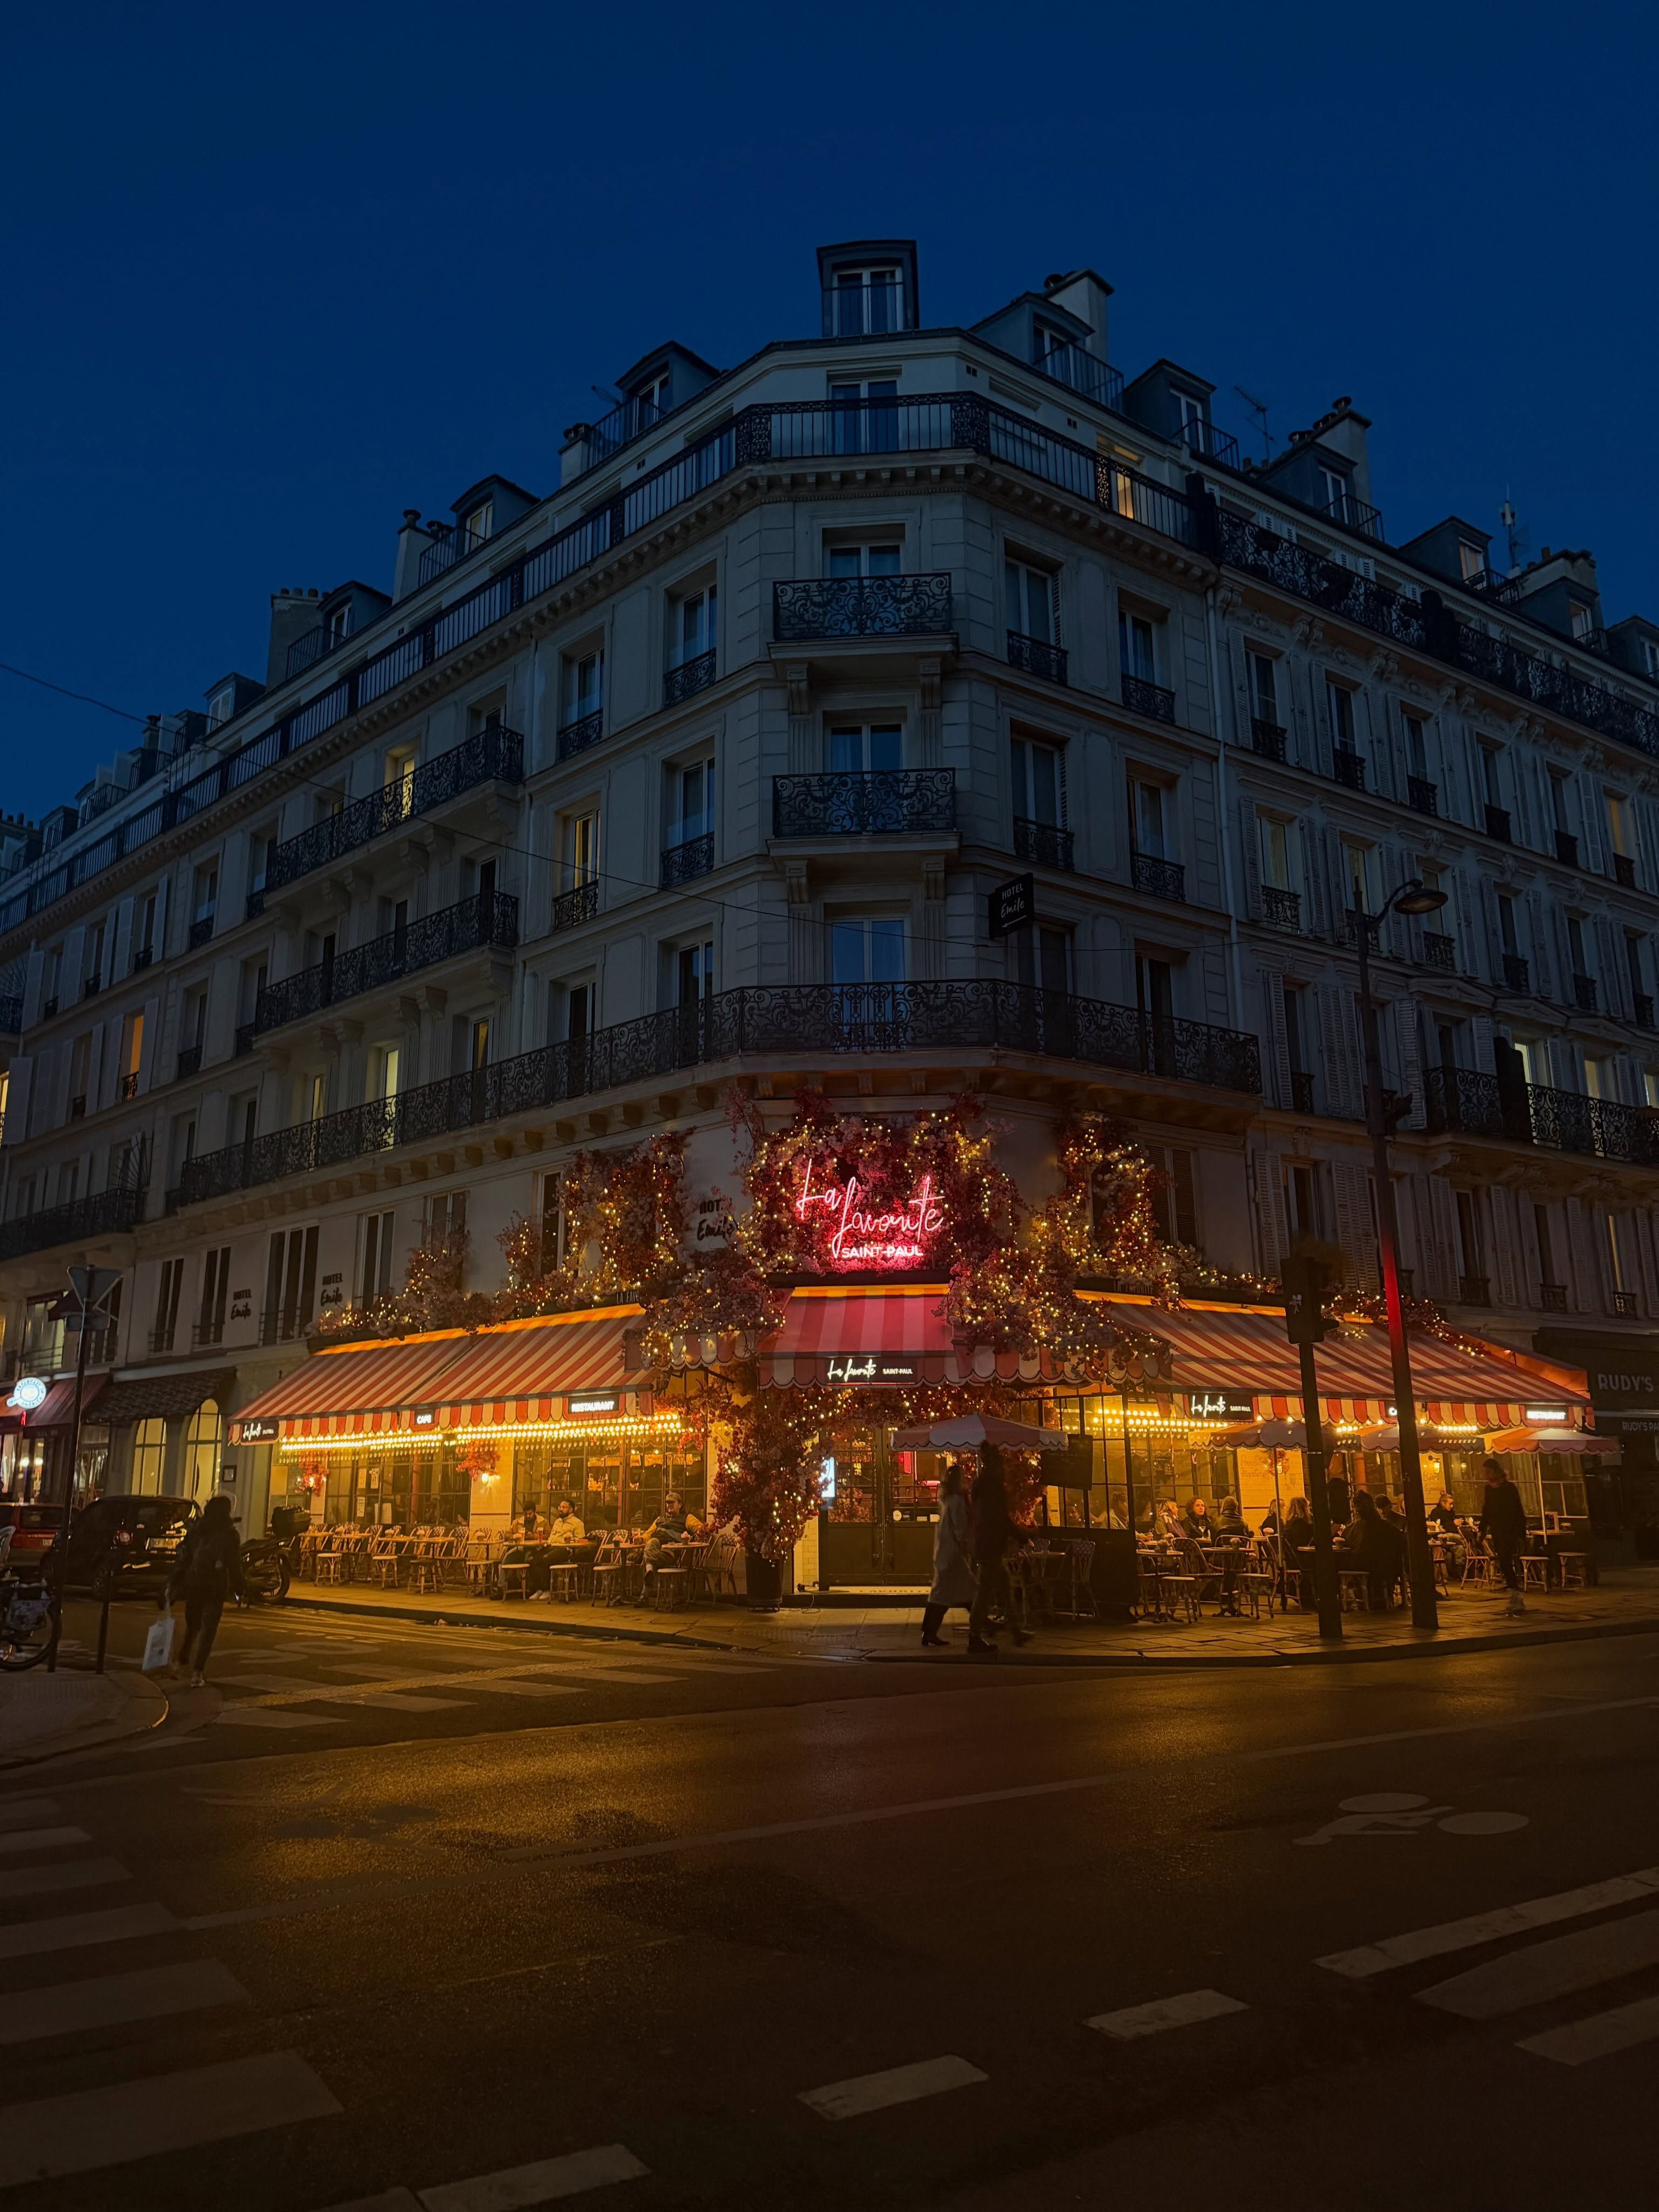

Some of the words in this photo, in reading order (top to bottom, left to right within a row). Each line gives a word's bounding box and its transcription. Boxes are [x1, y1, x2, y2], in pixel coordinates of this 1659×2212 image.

[1002, 883, 1023, 900] HOTEL
[1001, 898, 1024, 918] Emile
[796, 1158, 842, 1220] La
[841, 1245, 923, 1258] SAINT-PAUL
[323, 1273, 343, 1285] HOTEL
[233, 1289, 252, 1300] HOTEL
[320, 1287, 343, 1306] Emile
[231, 1302, 251, 1320] Emile
[827, 1360, 844, 1380] La
[1597, 1374, 1654, 1392] RUDY'S
[571, 1401, 615, 1412] RESTAURANT
[1622, 1421, 1648, 1431] RUDY'S
[1649, 1422, 1659, 1431] PA
